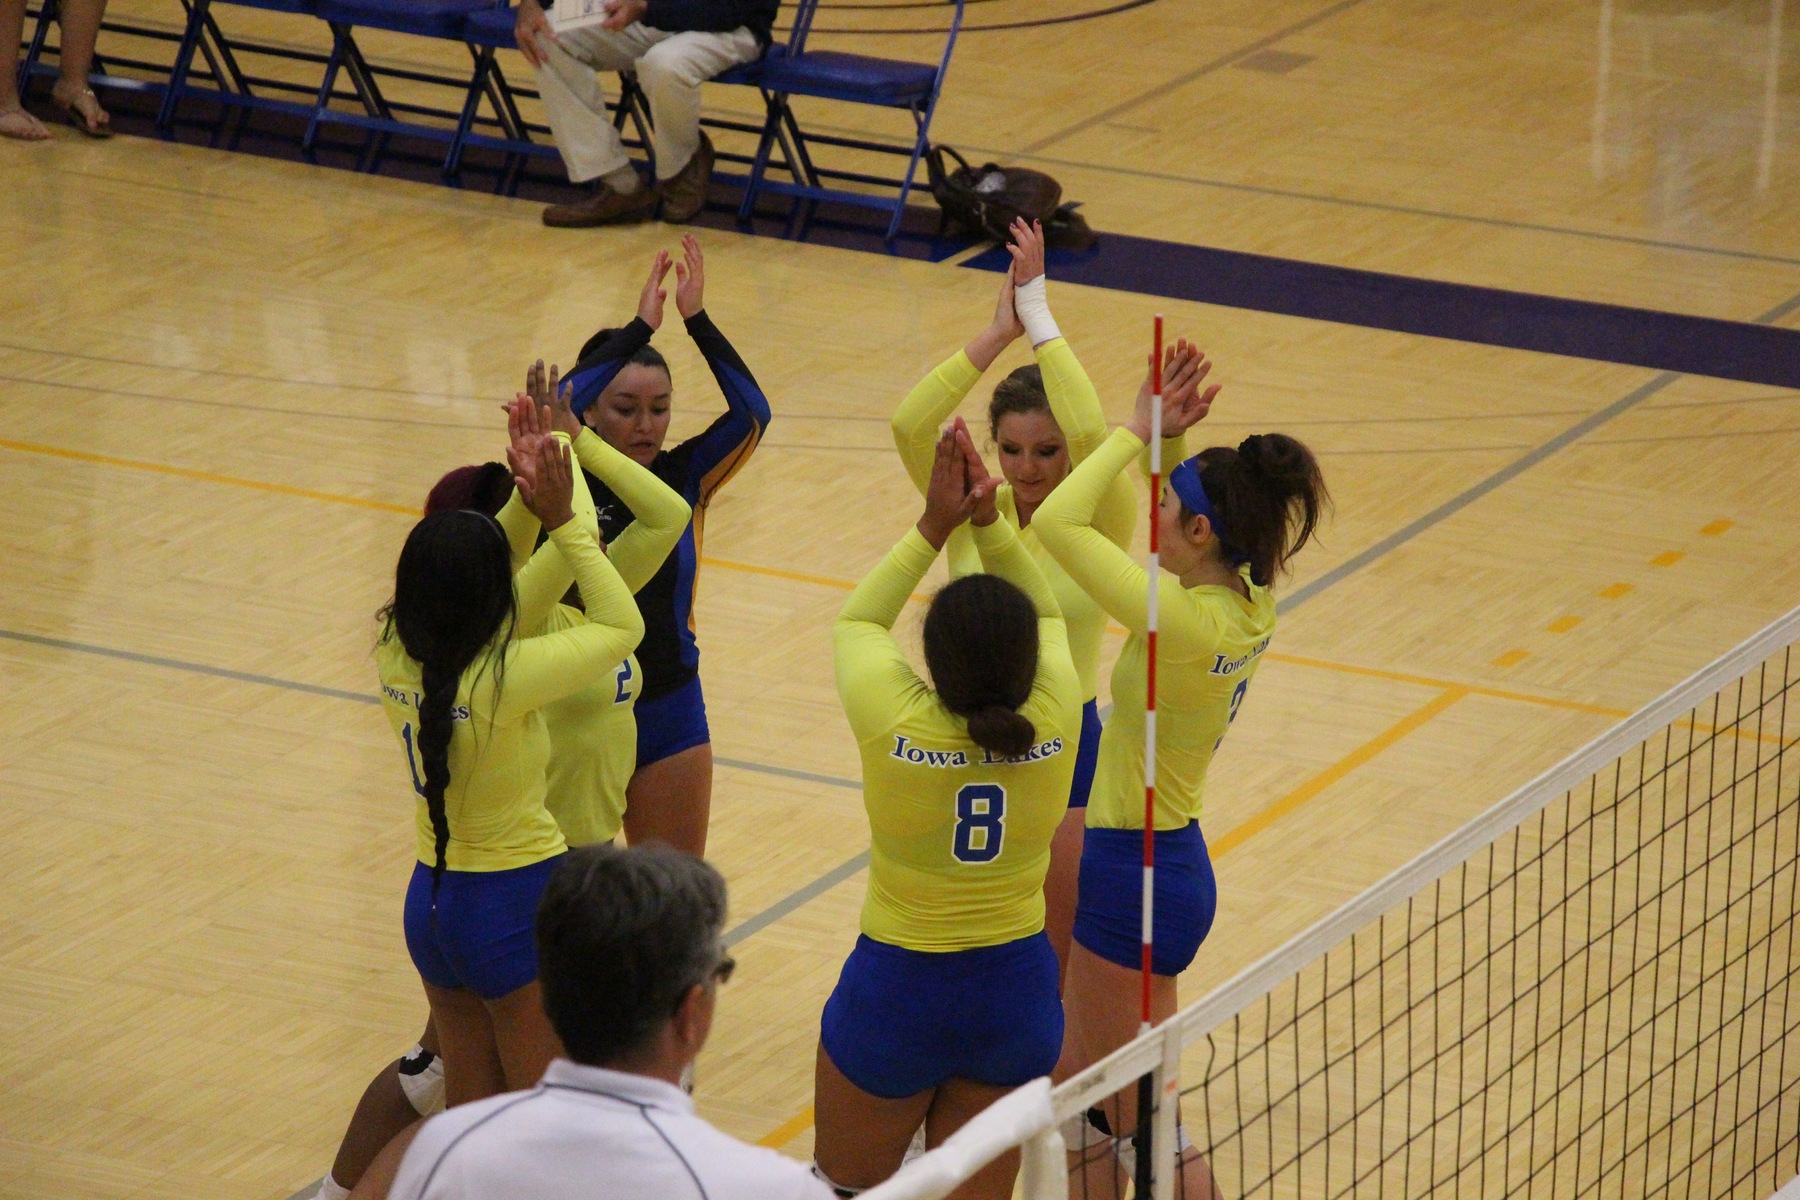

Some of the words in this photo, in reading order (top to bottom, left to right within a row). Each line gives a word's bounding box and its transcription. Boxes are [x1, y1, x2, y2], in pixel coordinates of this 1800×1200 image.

[614, 658, 633, 705] 2
[1209, 654, 1247, 675] Iowa
[381, 684, 409, 706] owa
[413, 691, 469, 720] Les
[890, 735, 970, 768] Iowa
[979, 736, 1063, 766] Lkes
[951, 782, 1007, 865] 8
